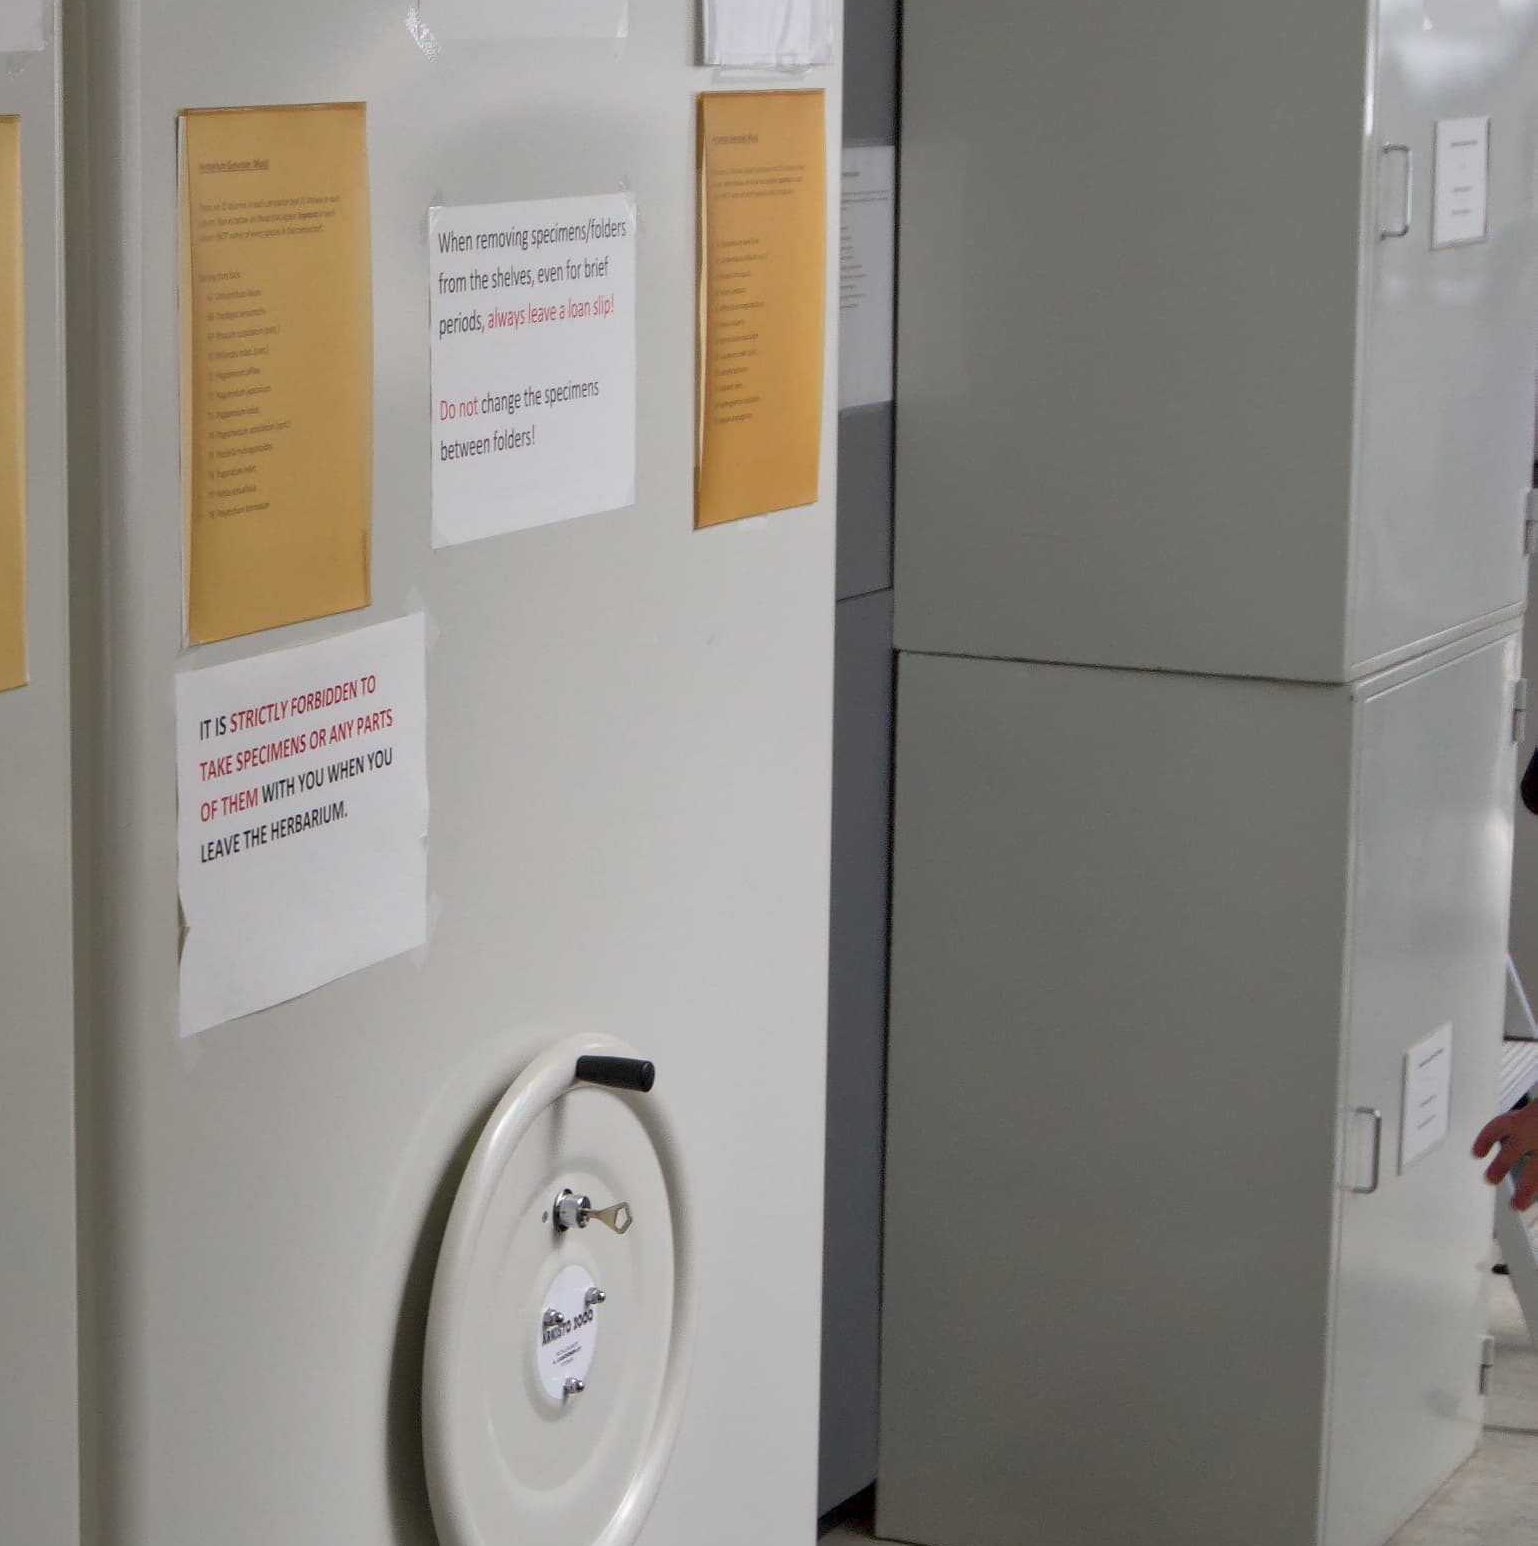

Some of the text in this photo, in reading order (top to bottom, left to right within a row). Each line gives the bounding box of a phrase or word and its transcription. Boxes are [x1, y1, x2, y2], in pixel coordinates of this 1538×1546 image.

[438, 217, 627, 254] When removing specimens/folders
[438, 255, 609, 295] from the shelves, even for brief
[439, 294, 614, 340] periods, always leave a loan slip!
[439, 379, 599, 421] Do not change the specimens
[440, 424, 535, 461] between folders!
[200, 674, 376, 741] IT IS STRICTLY FORBIDDEN TO
[200, 708, 393, 782] TAKE SPECIMENS OR ANY PARTS
[200, 747, 393, 822] OF THEM WITH YOU WHEN YOU
[201, 800, 348, 864] LEAVE THE HERBARIUM.
[542, 1308, 593, 1347] ARKISTO 2000
